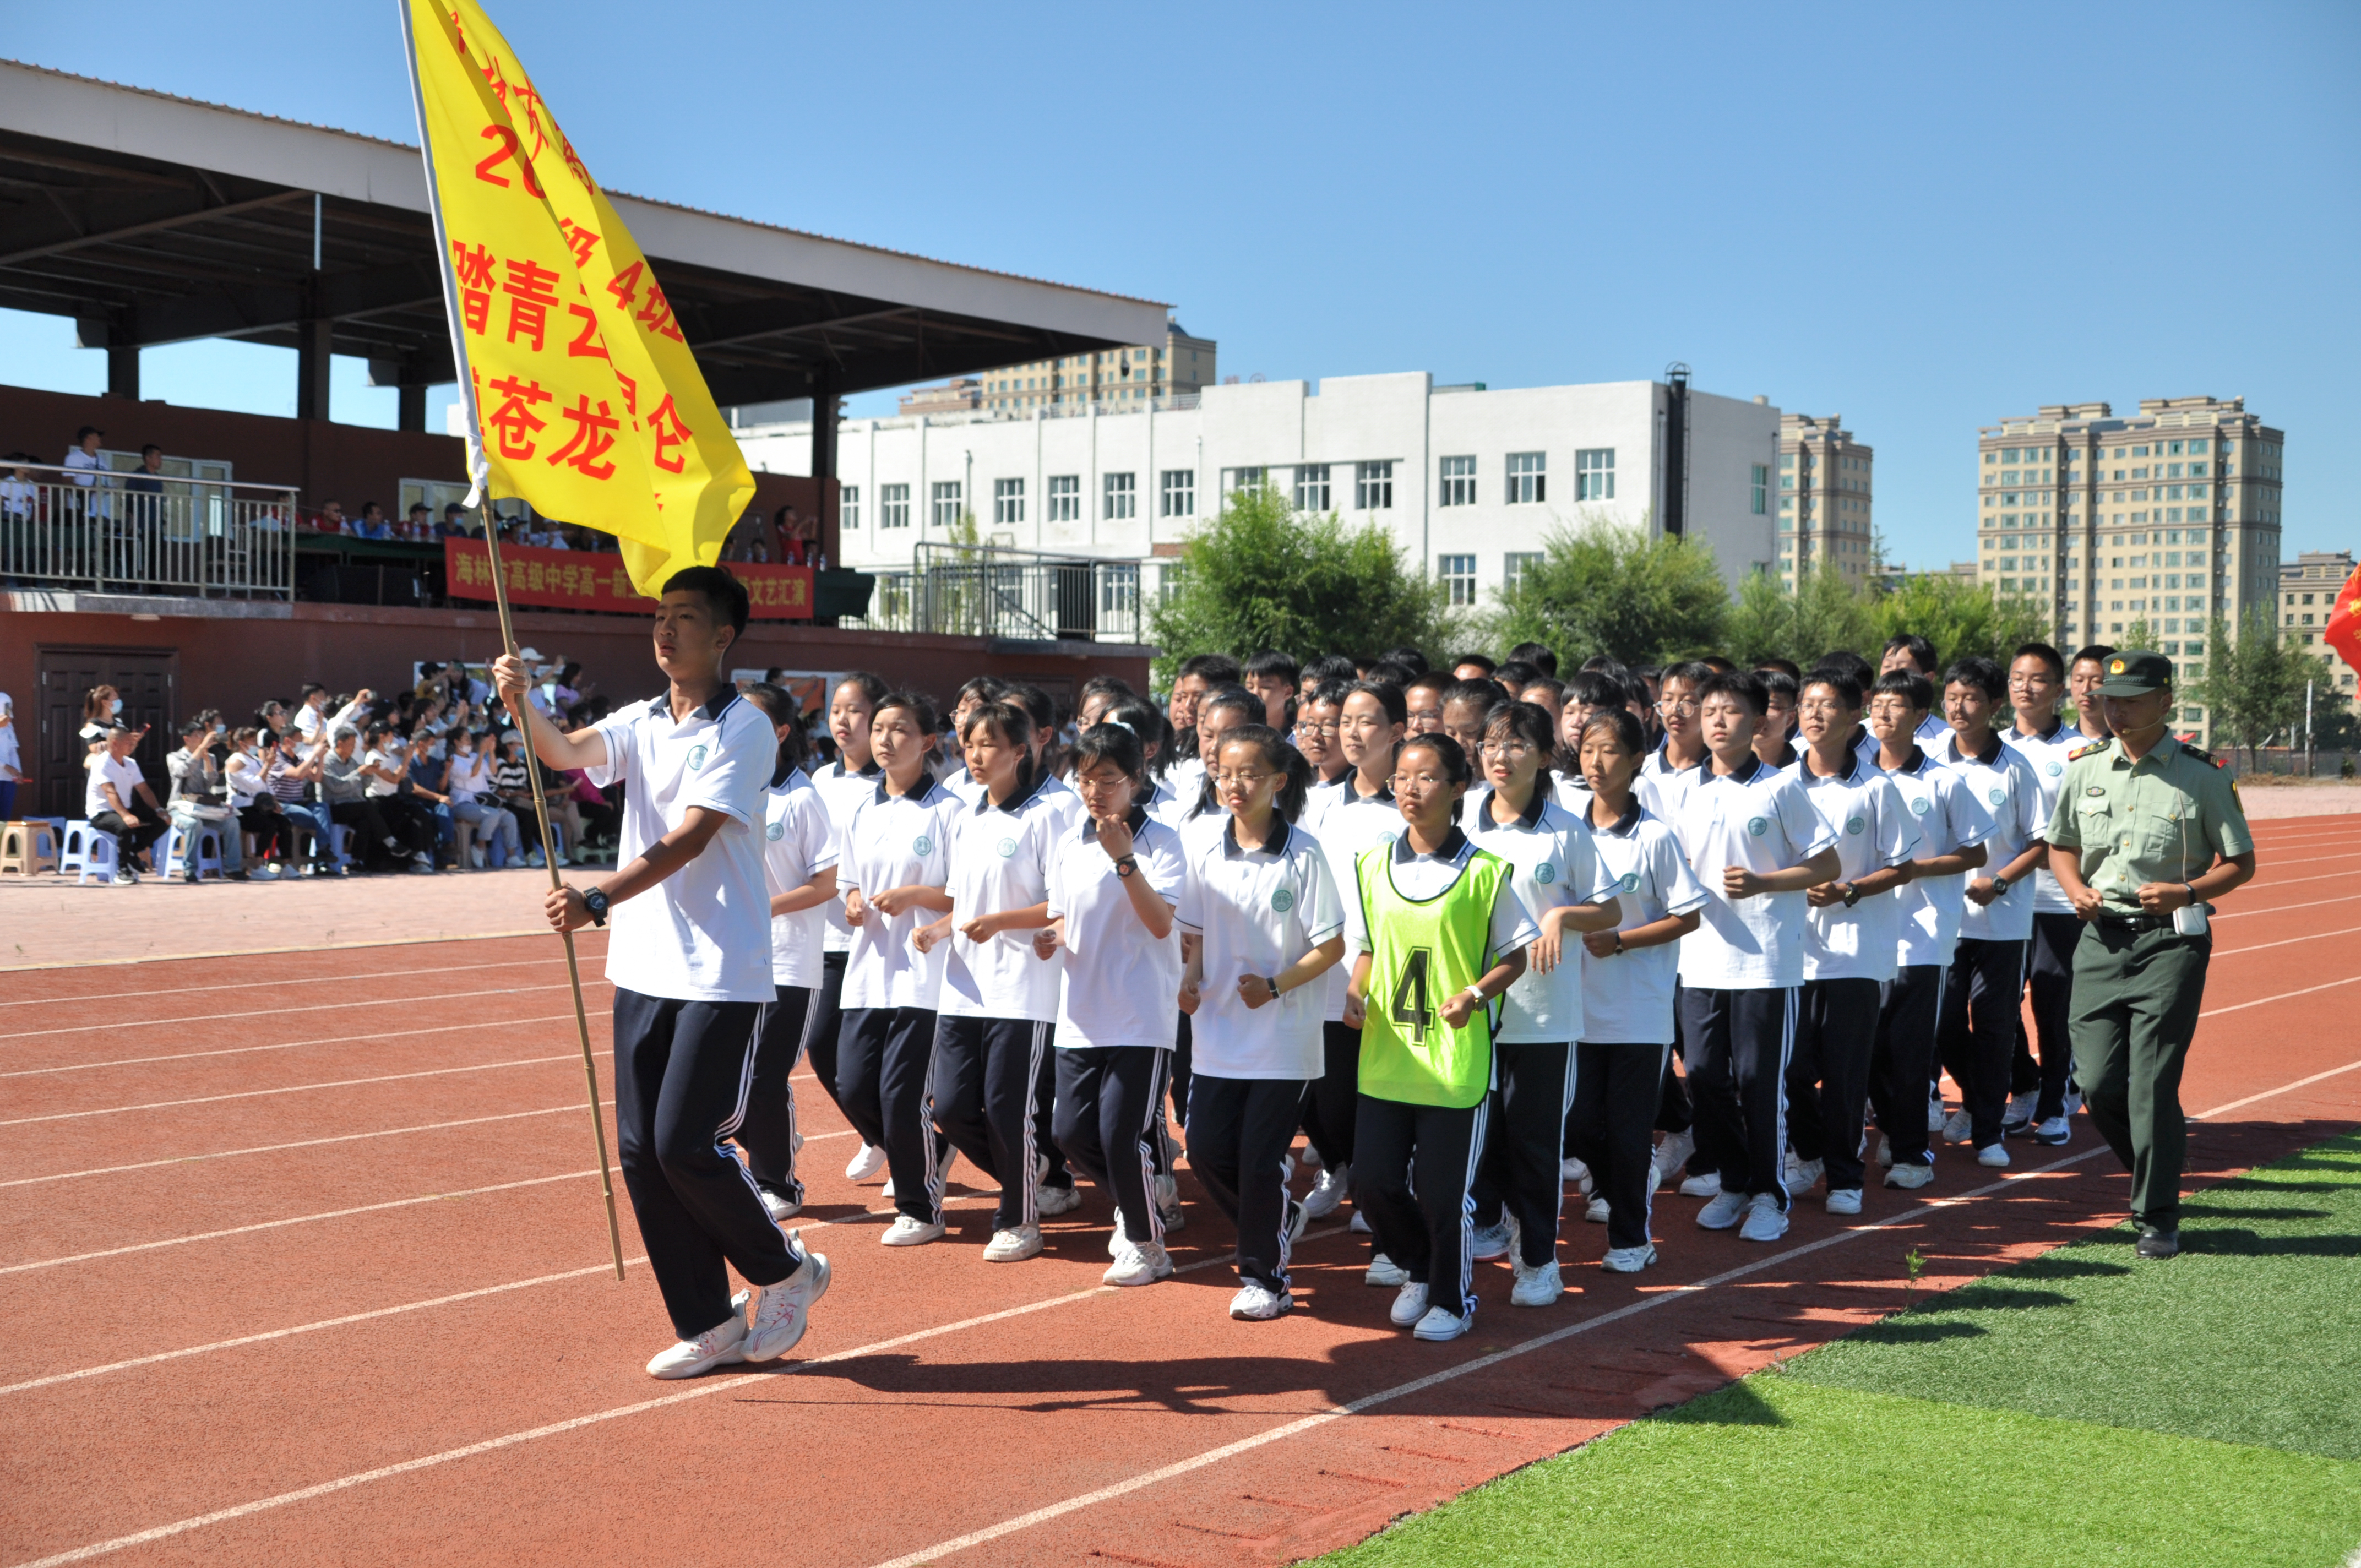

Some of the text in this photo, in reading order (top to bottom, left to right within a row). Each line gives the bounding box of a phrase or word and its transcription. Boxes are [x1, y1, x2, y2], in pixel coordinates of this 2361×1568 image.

[472, 366, 621, 481] 苍龙
[455, 552, 643, 600] 海林高级中学高一新
[1389, 945, 1435, 1047] 4
